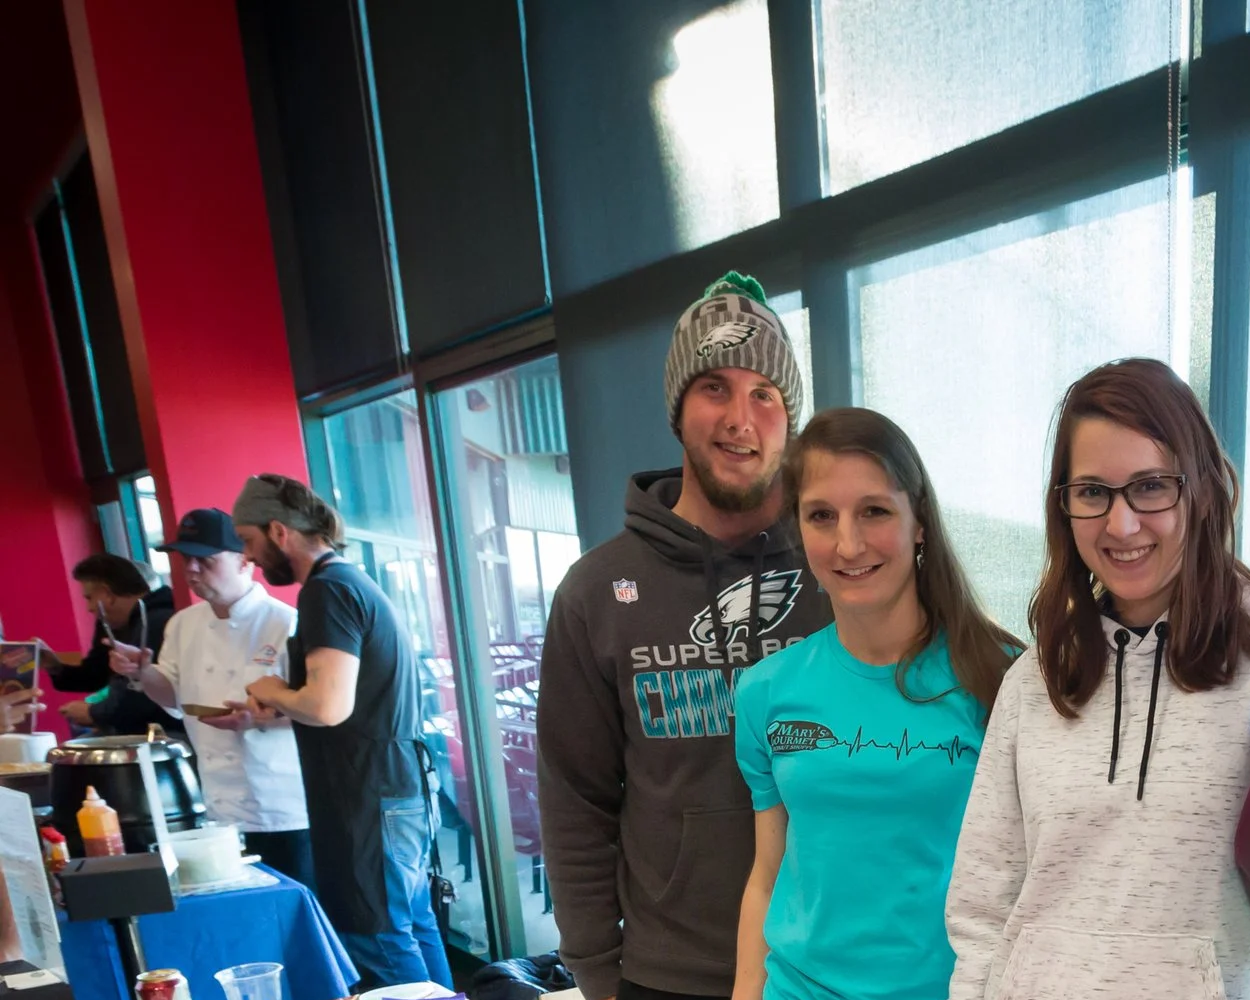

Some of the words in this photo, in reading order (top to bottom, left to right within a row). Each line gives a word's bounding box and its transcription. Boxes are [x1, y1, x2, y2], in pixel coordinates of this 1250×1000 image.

[616, 587, 635, 601] NFL
[630, 642, 749, 668] SUPER
[777, 722, 827, 739] MARY'S
